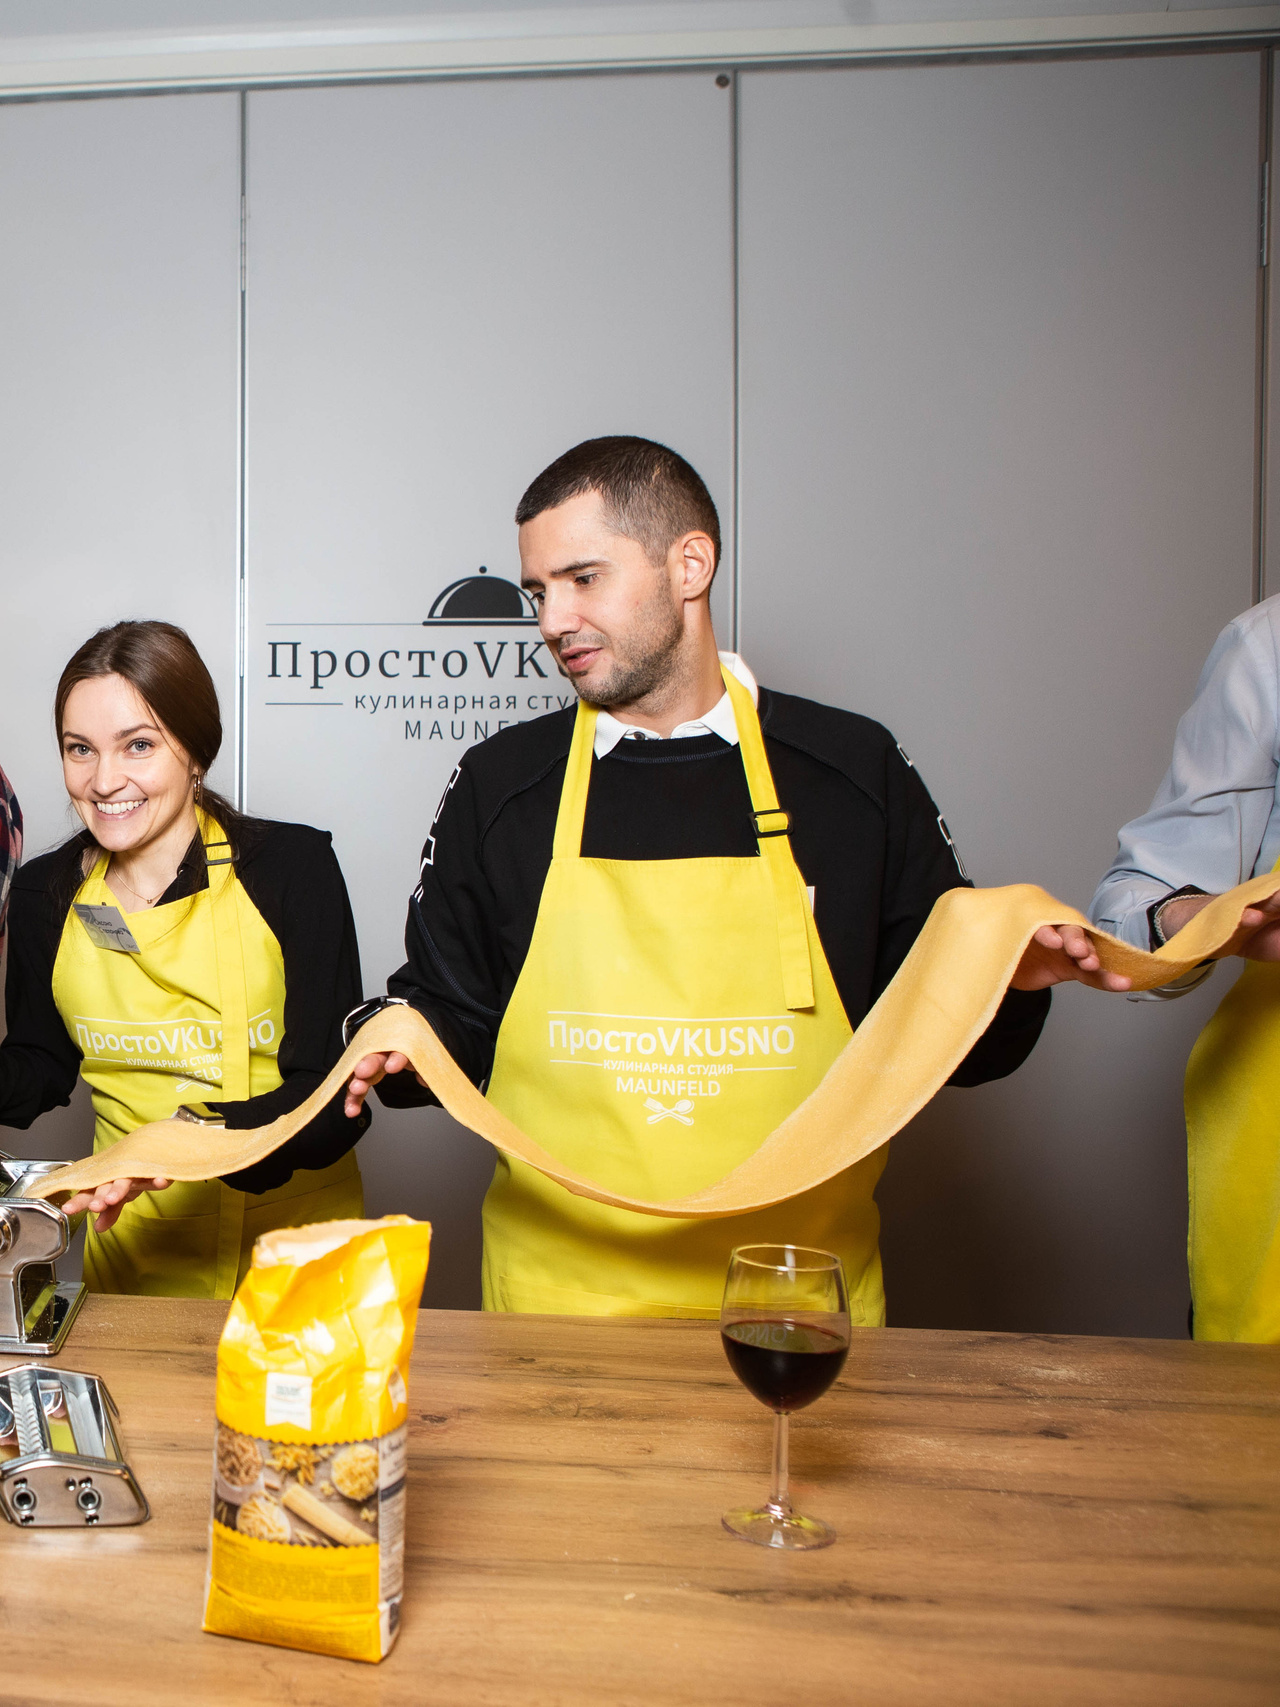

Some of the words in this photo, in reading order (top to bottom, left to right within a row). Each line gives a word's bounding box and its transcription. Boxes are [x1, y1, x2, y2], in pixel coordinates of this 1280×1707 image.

[267, 641, 568, 689] ПростоVK
[354, 694, 517, 714] кулинарная
[527, 695, 578, 710] сту
[548, 1020, 795, 1057] ПростоVKUSNO
[125, 1057, 188, 1068] КУЛИНАРНАЯ
[189, 1053, 222, 1066] СТУДИ
[603, 1059, 684, 1075] КУЛИНАРНАЯ
[687, 1063, 734, 1077] СТУДИЯ
[616, 1076, 721, 1097] MAUNFELD
